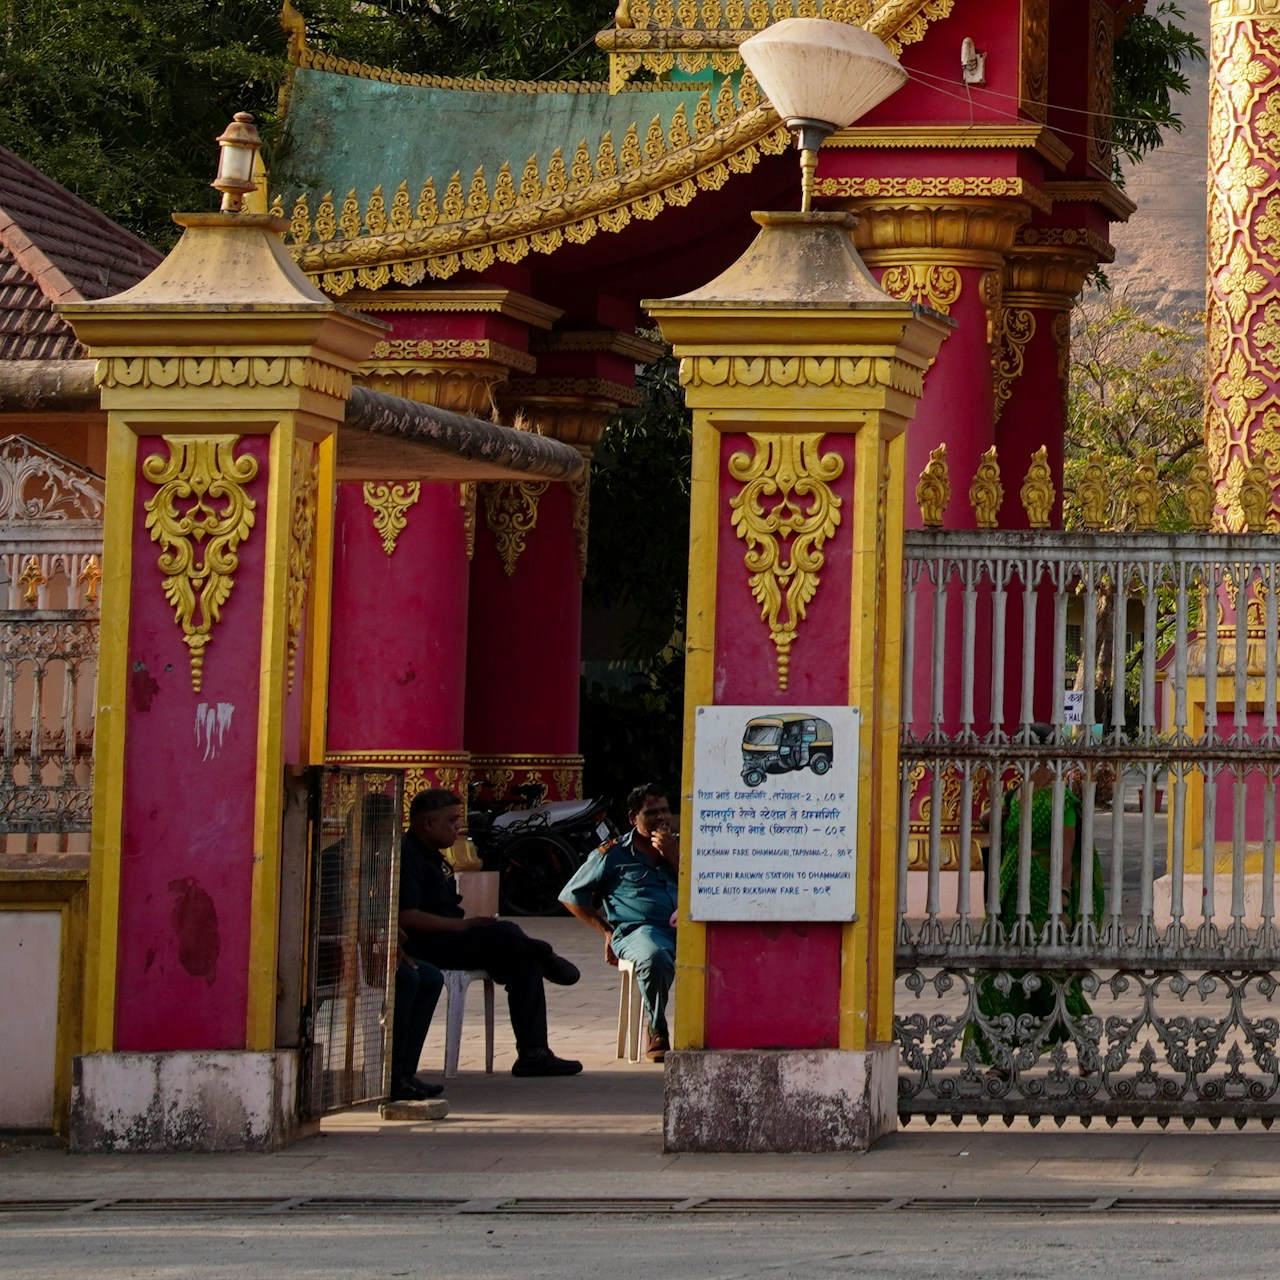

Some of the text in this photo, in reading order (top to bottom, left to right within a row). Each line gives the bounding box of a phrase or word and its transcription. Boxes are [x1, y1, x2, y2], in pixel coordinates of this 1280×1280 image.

[791, 807, 798, 819] ते
[696, 849, 730, 857] RICKSHAW
[733, 849, 750, 857] FARE
[699, 872, 733, 880] IGATPURI
[735, 872, 764, 880] RAILWAY
[809, 872, 851, 880] DHAMMAGIRI
[698, 887, 720, 895] WHOLE
[723, 887, 741, 895] AUTO
[743, 887, 778, 895] RICKSHAW
[780, 887, 800, 895] FARE
